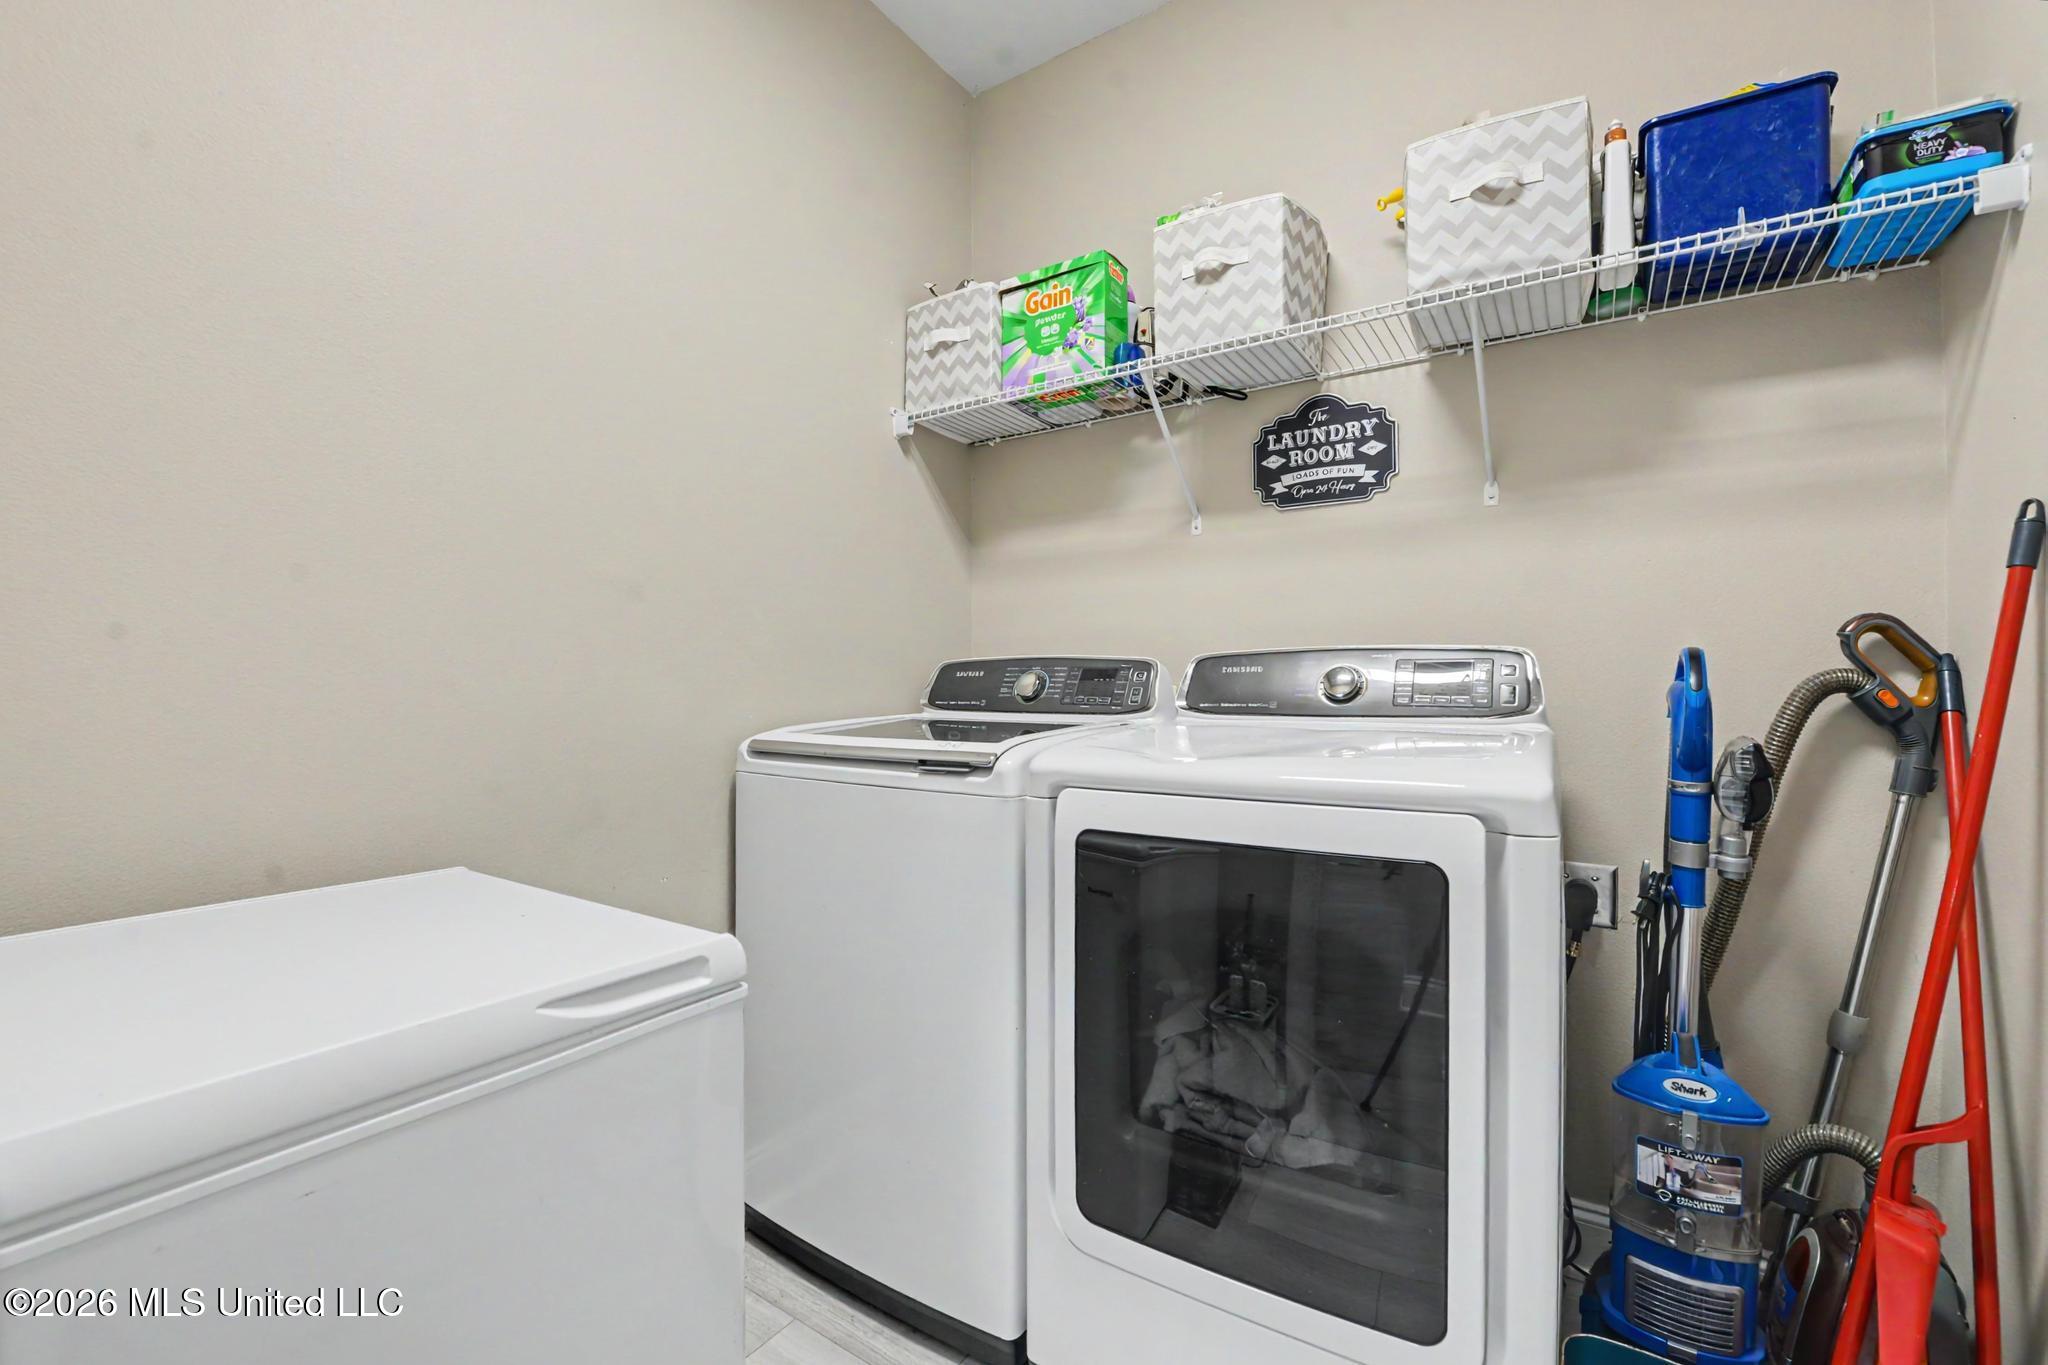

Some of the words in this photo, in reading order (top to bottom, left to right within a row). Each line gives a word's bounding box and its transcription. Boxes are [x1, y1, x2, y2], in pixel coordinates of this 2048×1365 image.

[1913, 137, 1947, 151] HEAVY
[1916, 145, 1944, 157] DUTY
[1025, 283, 1072, 315] Gain
[1308, 406, 1329, 426] The
[1267, 417, 1380, 451] LAUNDRY
[1288, 442, 1356, 467] ROOM
[1292, 470, 1320, 482] LOADS
[1336, 467, 1355, 475] FUN
[1291, 485, 1314, 499] Open
[1670, 1081, 1707, 1098] Shark
[1657, 1143, 1720, 1164] LIFT-AWAY
